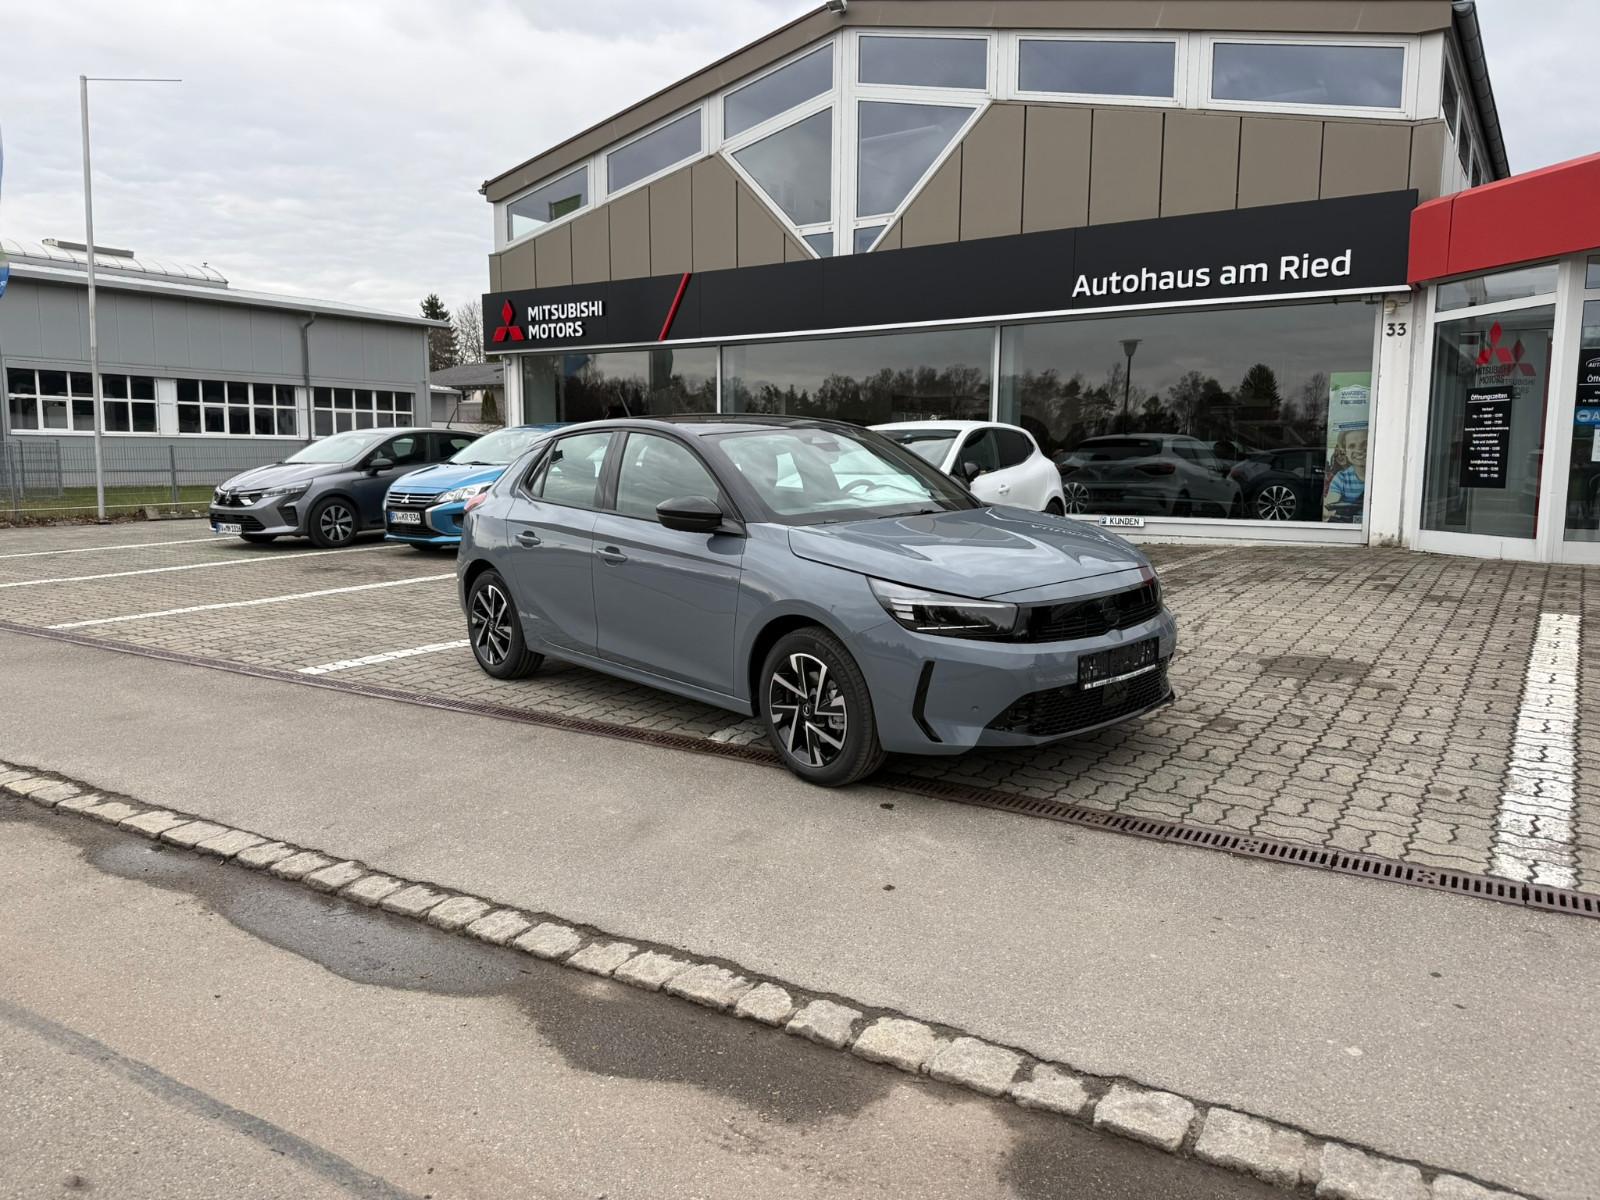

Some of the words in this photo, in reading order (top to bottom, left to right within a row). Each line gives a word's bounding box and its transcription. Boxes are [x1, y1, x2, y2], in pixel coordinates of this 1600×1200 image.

[1072, 266, 1211, 297] Autohaus
[1219, 261, 1269, 284] am
[1279, 249, 1352, 280] Ried
[527, 300, 604, 321] MITSUBISHI
[528, 320, 584, 340] MOTORS
[1386, 323, 1406, 336] 33
[1109, 517, 1140, 526] KUNDEN
